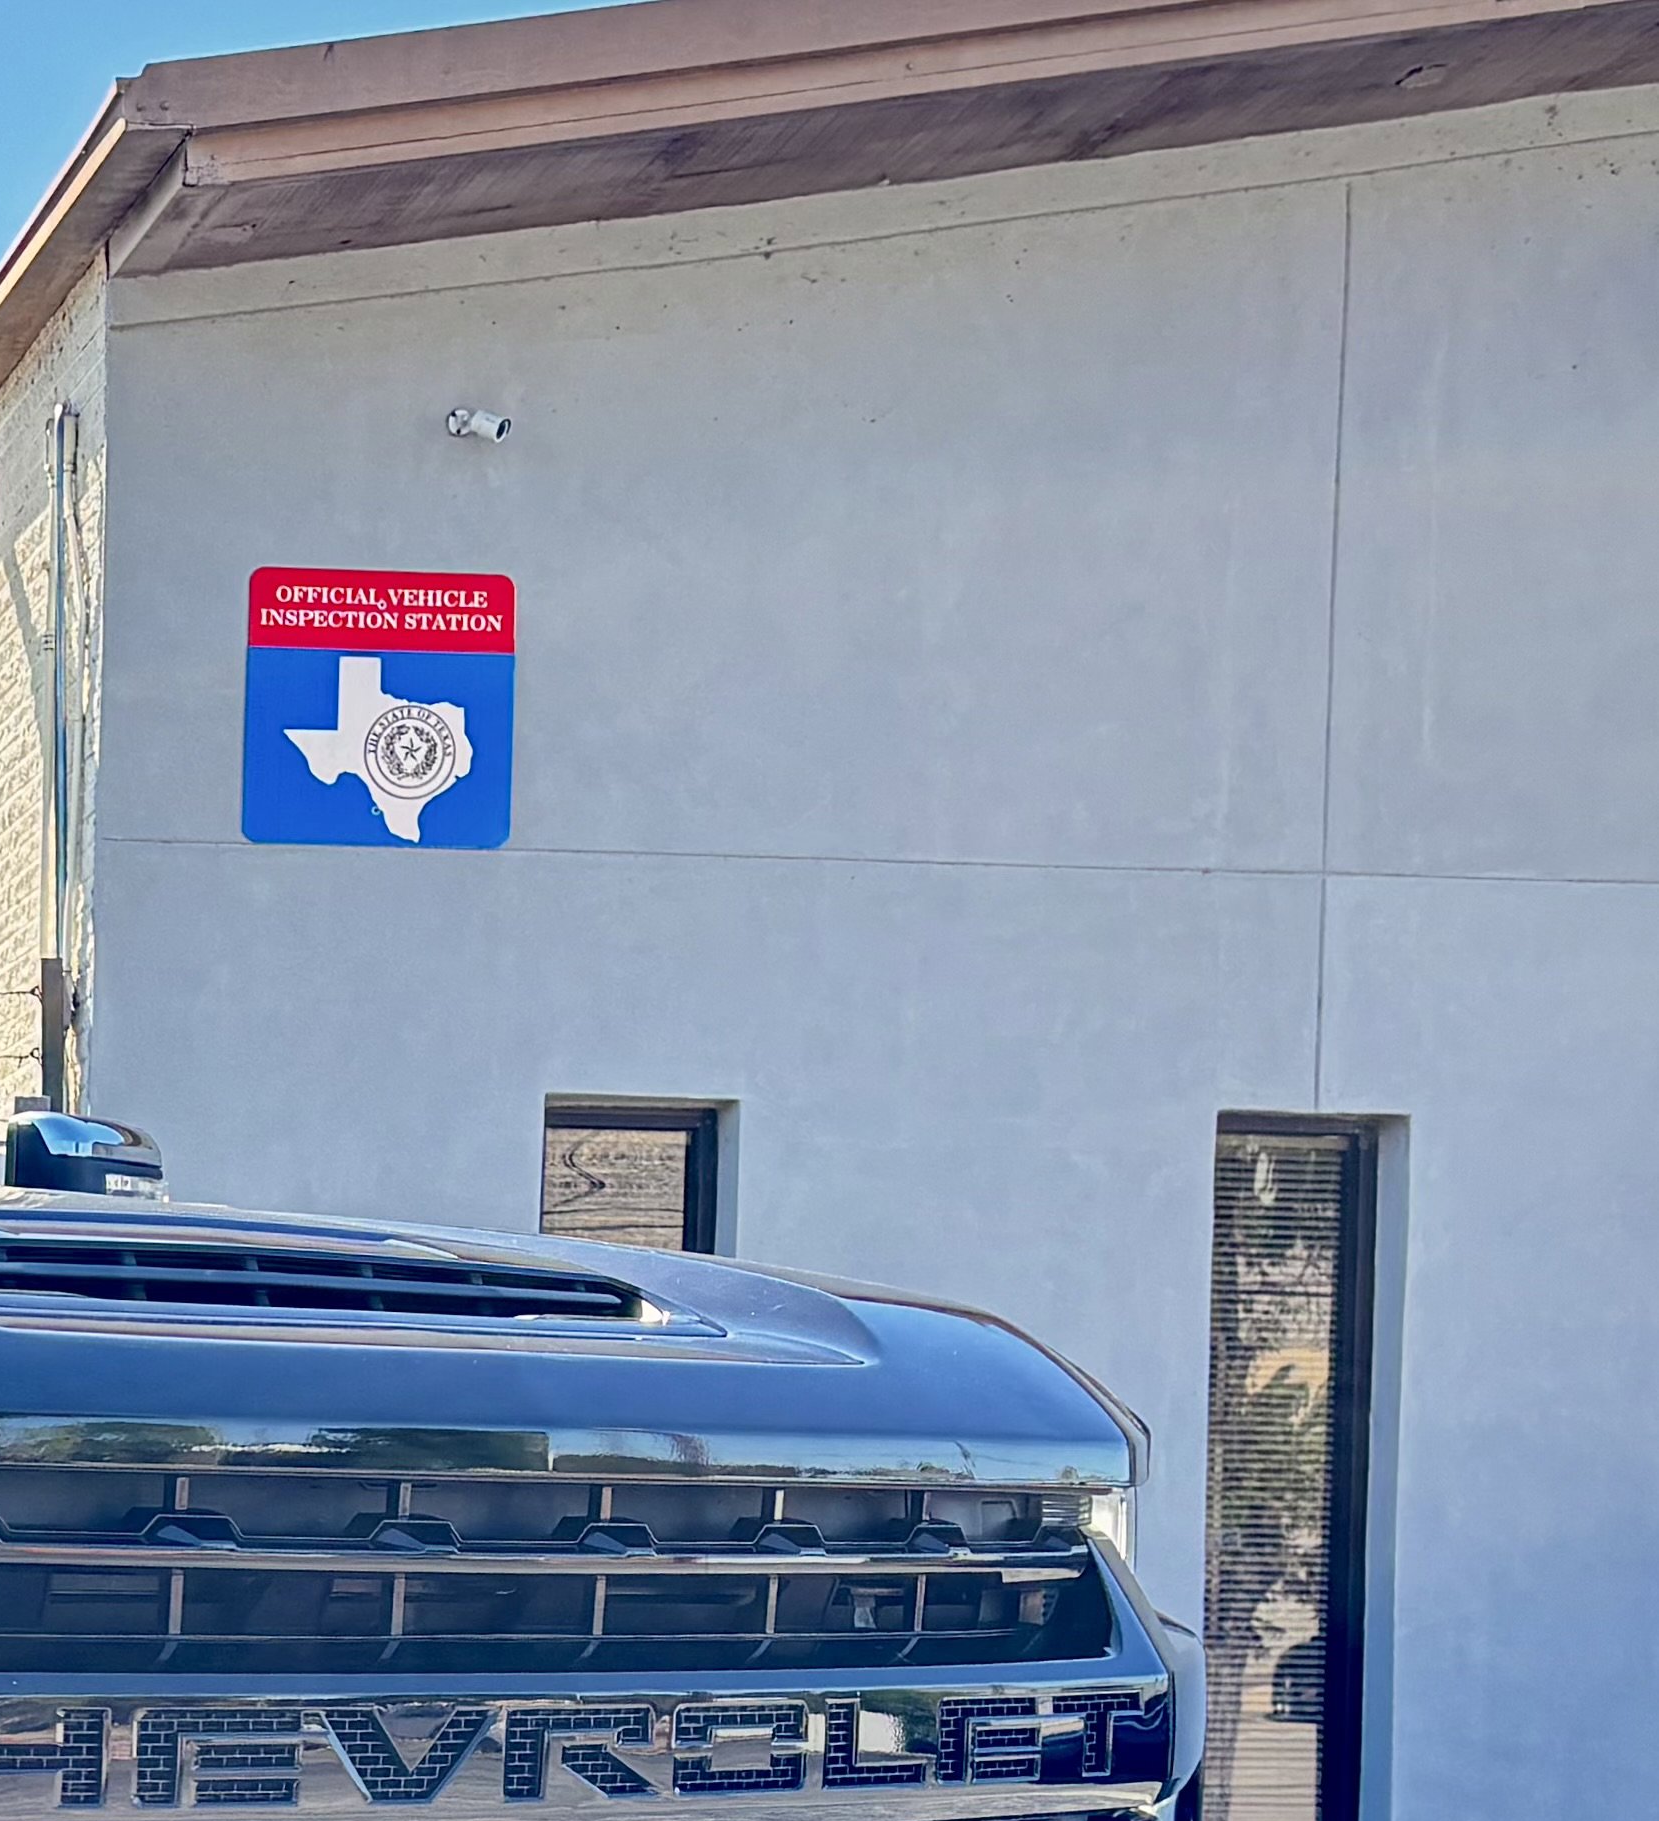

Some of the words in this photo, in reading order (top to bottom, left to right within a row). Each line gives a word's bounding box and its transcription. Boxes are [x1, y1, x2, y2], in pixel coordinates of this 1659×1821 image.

[275, 584, 379, 606] OFFICIAL
[387, 588, 488, 609] VEHICLE
[259, 608, 398, 631] INSPECTION
[404, 613, 503, 632] STATION
[367, 730, 382, 755] THE
[379, 708, 414, 729] STATE
[417, 709, 432, 721] OF
[433, 719, 453, 758] TEXAS
